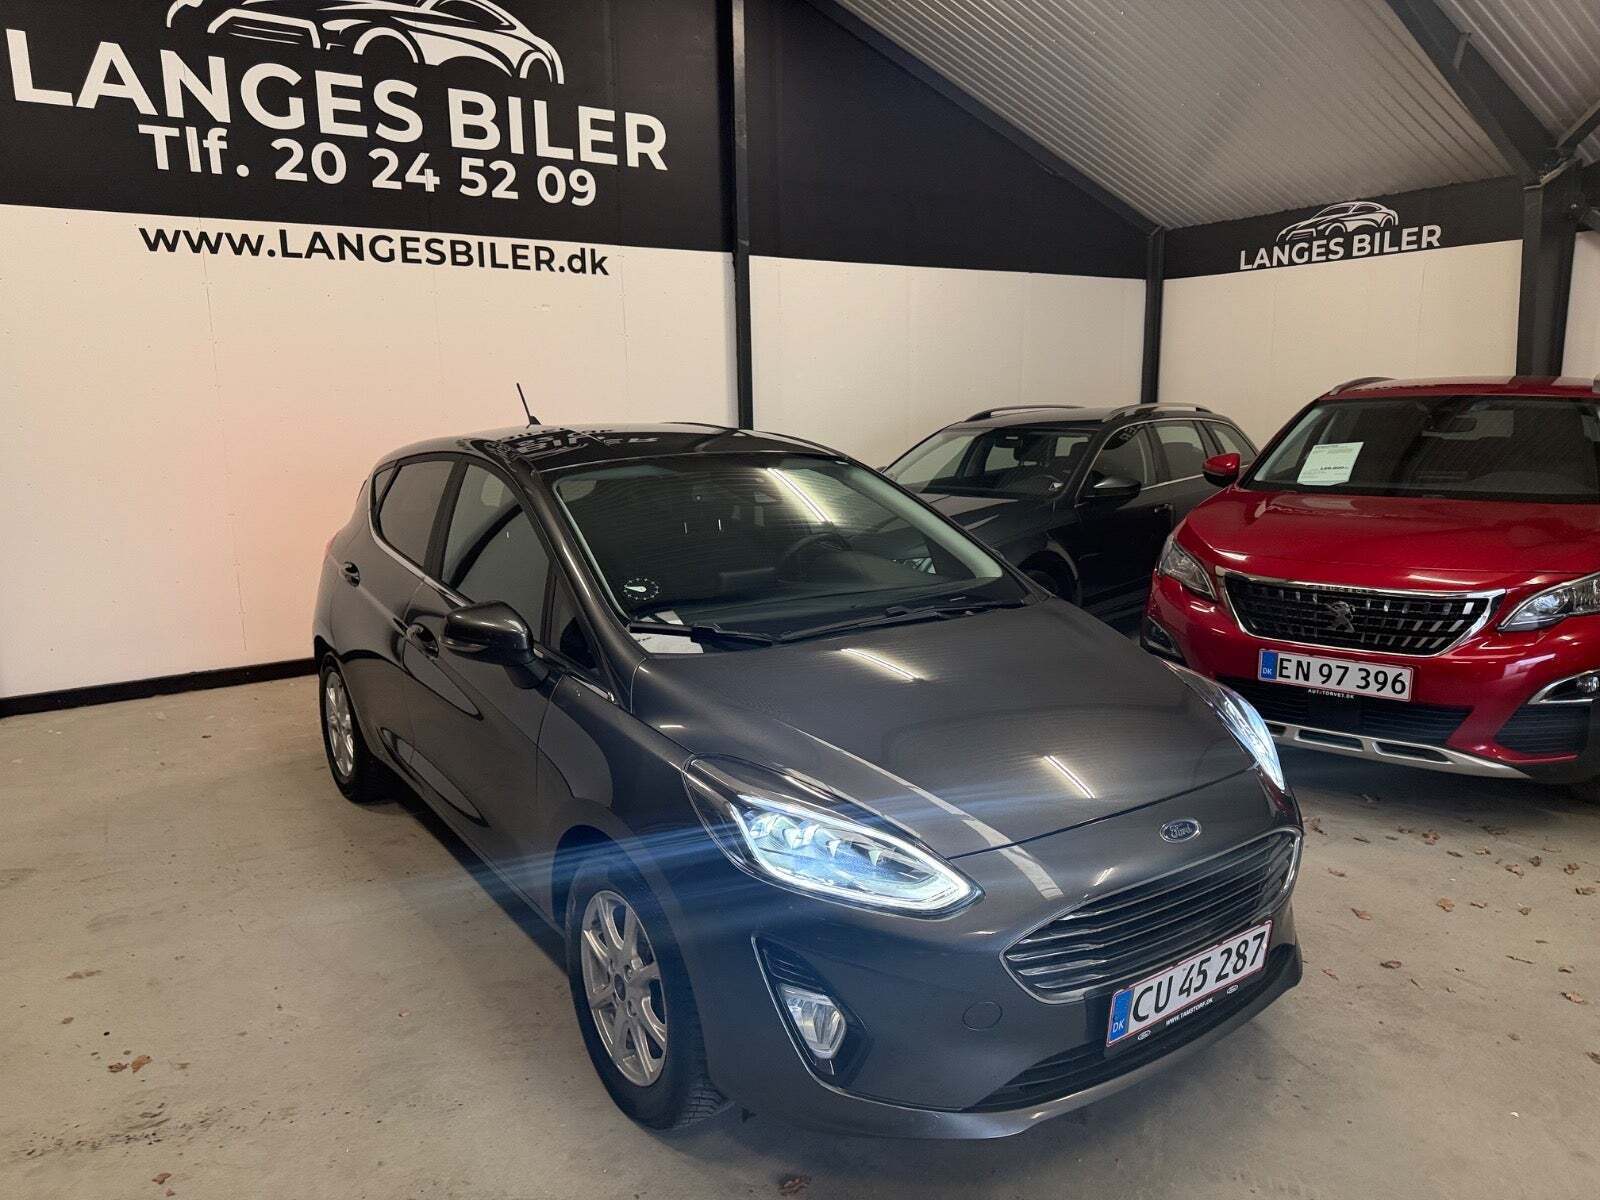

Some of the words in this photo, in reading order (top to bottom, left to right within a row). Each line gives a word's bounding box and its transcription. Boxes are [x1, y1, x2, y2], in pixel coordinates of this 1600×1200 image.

[5, 29, 425, 143] LANGES
[447, 88, 668, 171] BILER
[138, 124, 249, 177] Tlf.
[271, 138, 347, 185] 20
[367, 149, 440, 192] 24
[459, 158, 518, 200] 52
[536, 166, 597, 207] 09
[138, 227, 609, 276] www.LANGESBILER.dk
[1239, 237, 1345, 270] LANGES
[1352, 224, 1441, 257] BILER
[1278, 657, 1311, 682] EN
[1318, 663, 1349, 686] 97
[1356, 667, 1406, 695] 396
[1112, 1019, 1125, 1033] DK
[1133, 975, 1173, 1022] CU
[1178, 957, 1212, 997] 45
[1215, 932, 1266, 983] 287
